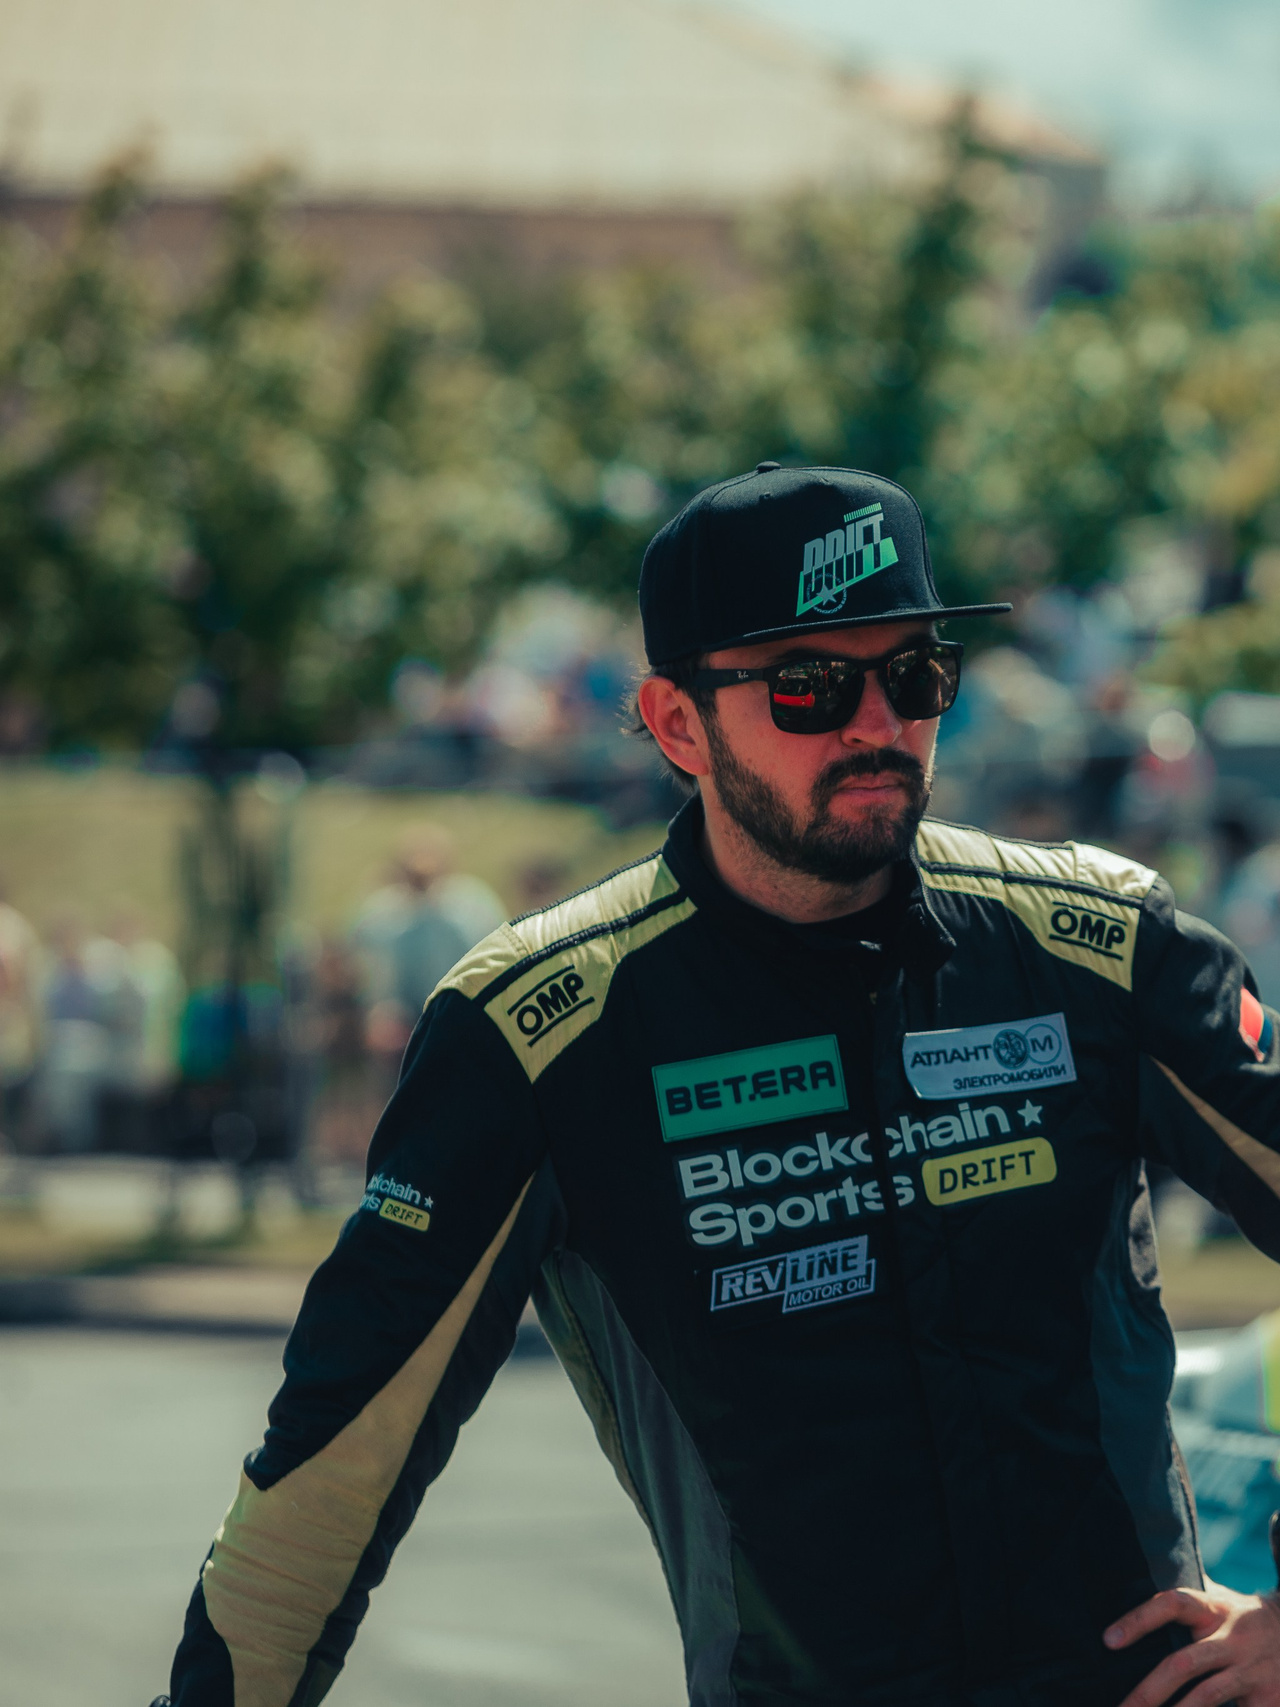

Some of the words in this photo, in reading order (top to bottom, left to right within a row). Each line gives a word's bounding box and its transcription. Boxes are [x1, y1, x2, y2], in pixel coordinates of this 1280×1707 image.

[1050, 907, 1126, 950] OMP
[516, 971, 584, 1036] OMP
[910, 1044, 993, 1068] АТЛАНТ
[953, 1064, 1067, 1090] ЭЛЕКТРОМОБИЛИ
[678, 1102, 1011, 1199] Blockchain
[384, 1203, 424, 1226] DRIFT
[688, 1175, 916, 1247] Sports
[938, 1149, 1036, 1196] DRIFT
[788, 1281, 843, 1307] MOTOR
[846, 1277, 871, 1293] OIL
